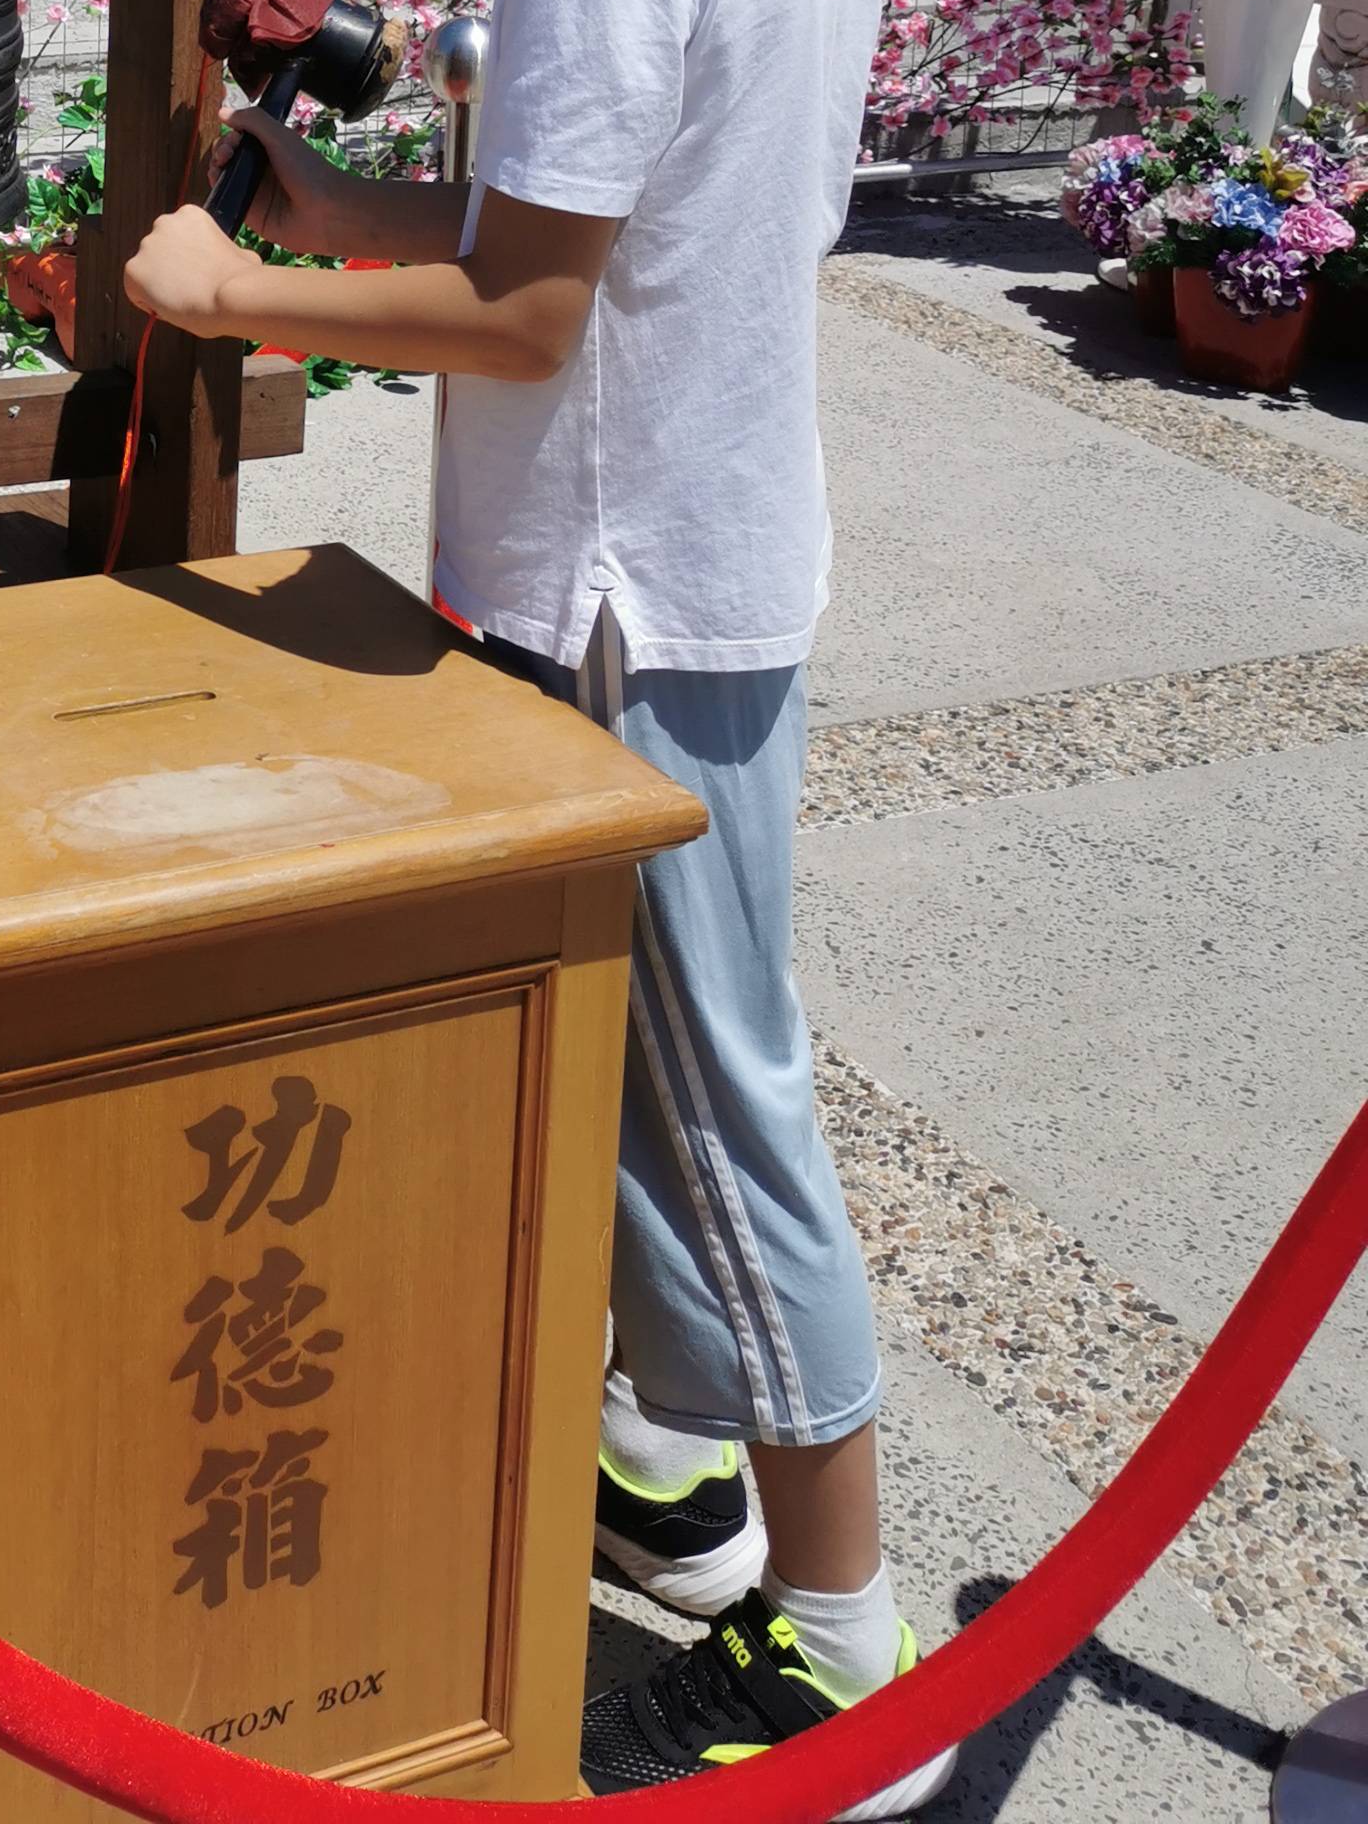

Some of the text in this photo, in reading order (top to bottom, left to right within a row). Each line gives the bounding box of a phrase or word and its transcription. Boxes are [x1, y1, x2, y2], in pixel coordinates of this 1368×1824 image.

[169, 1075, 353, 1612] 功德箱
[190, 1670, 387, 1745] TION BOX
